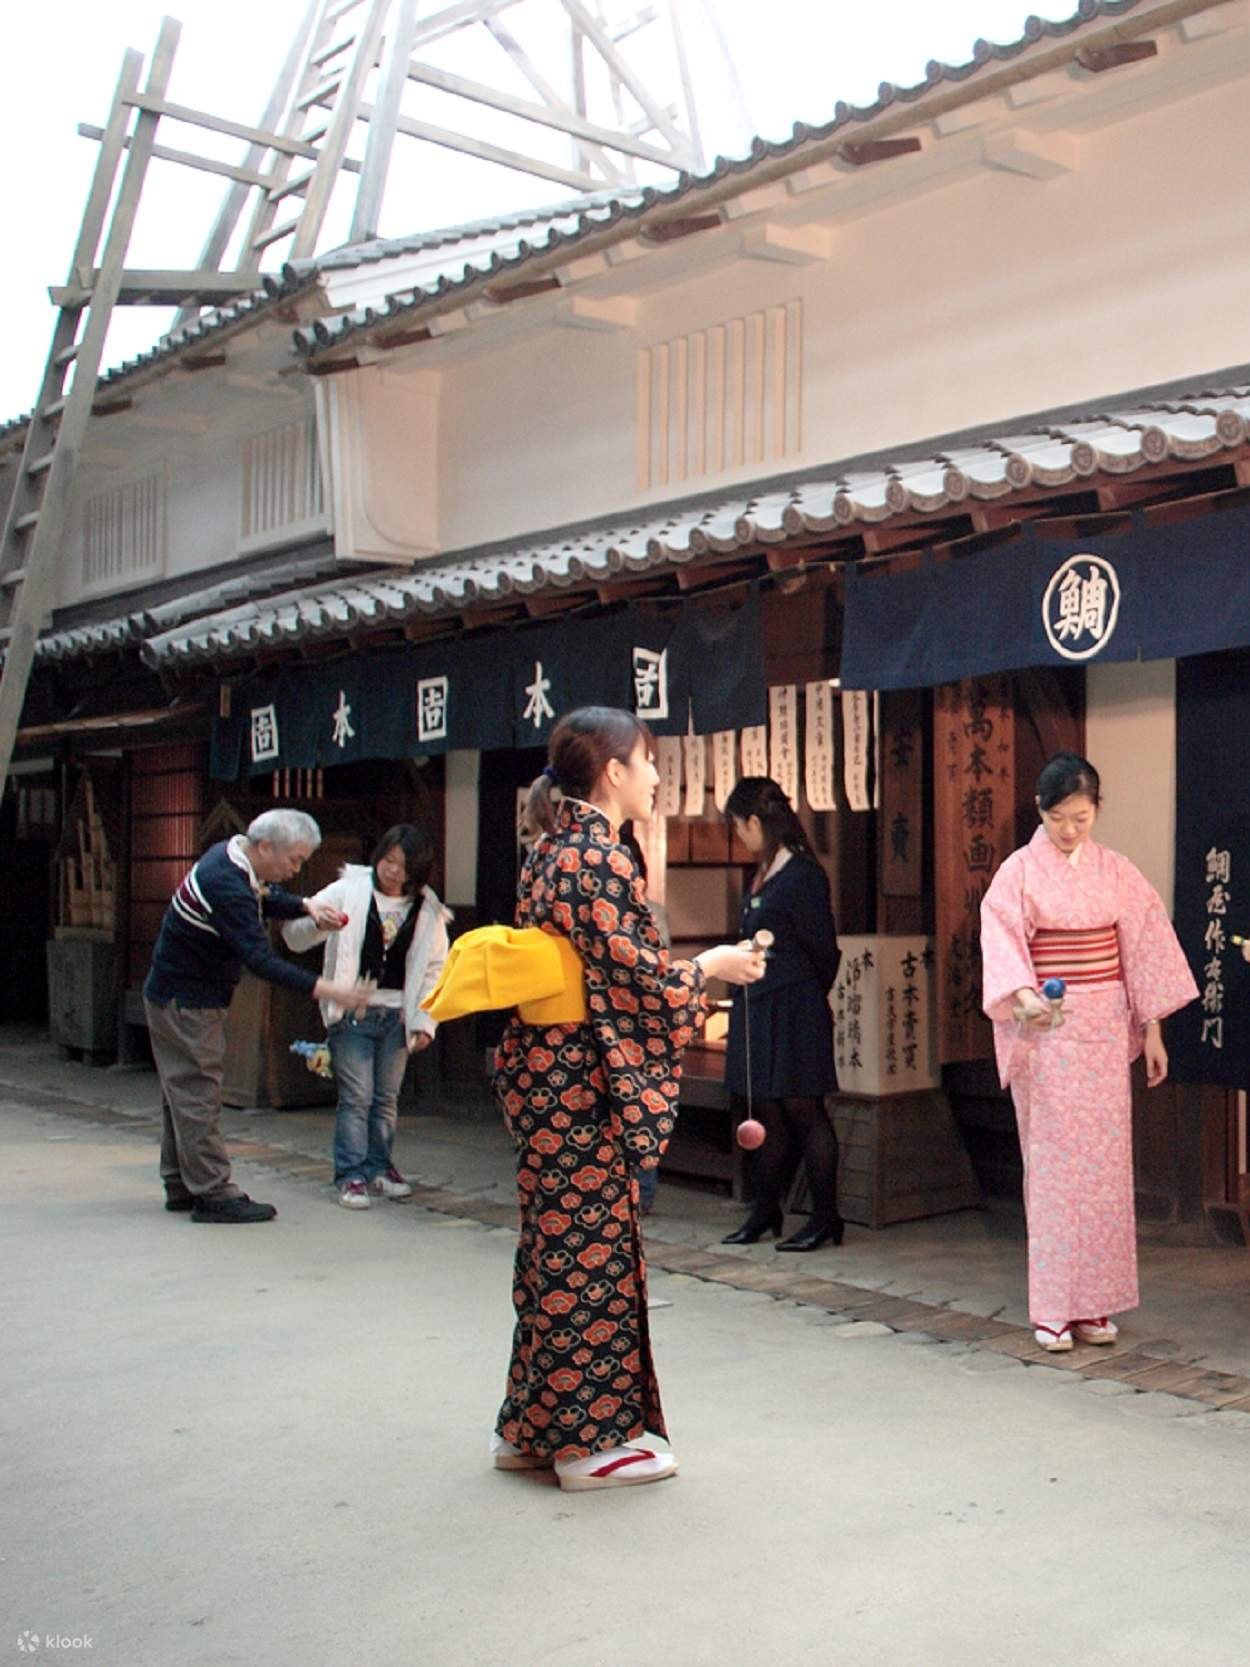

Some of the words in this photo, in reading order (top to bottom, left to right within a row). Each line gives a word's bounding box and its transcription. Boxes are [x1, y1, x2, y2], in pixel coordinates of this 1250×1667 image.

[1052, 565, 1108, 641] 鯛
[331, 689, 355, 748] 本
[523, 660, 555, 729] 本
